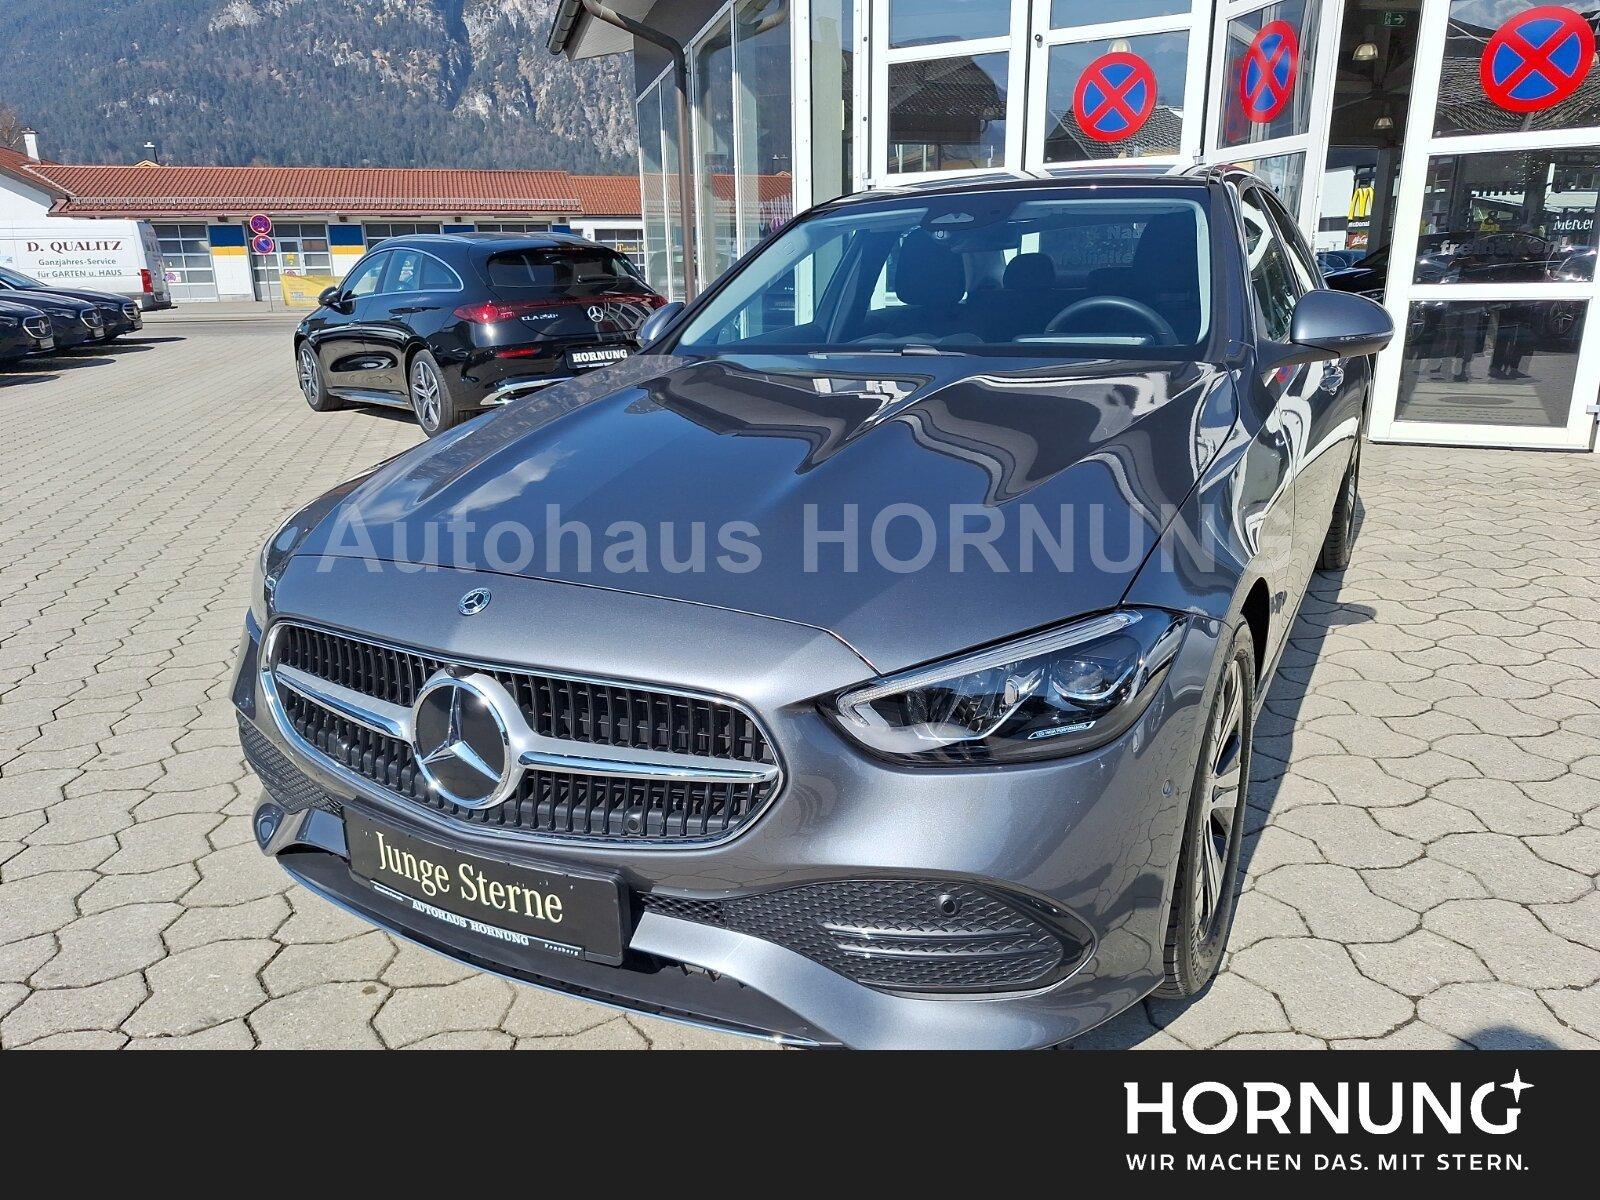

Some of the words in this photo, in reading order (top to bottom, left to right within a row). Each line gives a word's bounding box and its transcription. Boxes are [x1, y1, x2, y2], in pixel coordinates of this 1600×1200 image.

[26, 241, 44, 252] D.
[50, 241, 123, 254] QUALITZ
[38, 258, 117, 267] Ganzjahres-Service
[37, 270, 50, 278] für
[52, 270, 87, 278] GARTEN
[98, 269, 122, 277] HAUS
[572, 349, 628, 363] HORNUNG
[375, 831, 450, 897] Junge
[458, 863, 563, 923] Sterne
[412, 900, 467, 928] AUTOHAUS
[470, 920, 529, 946] HORNUNG
